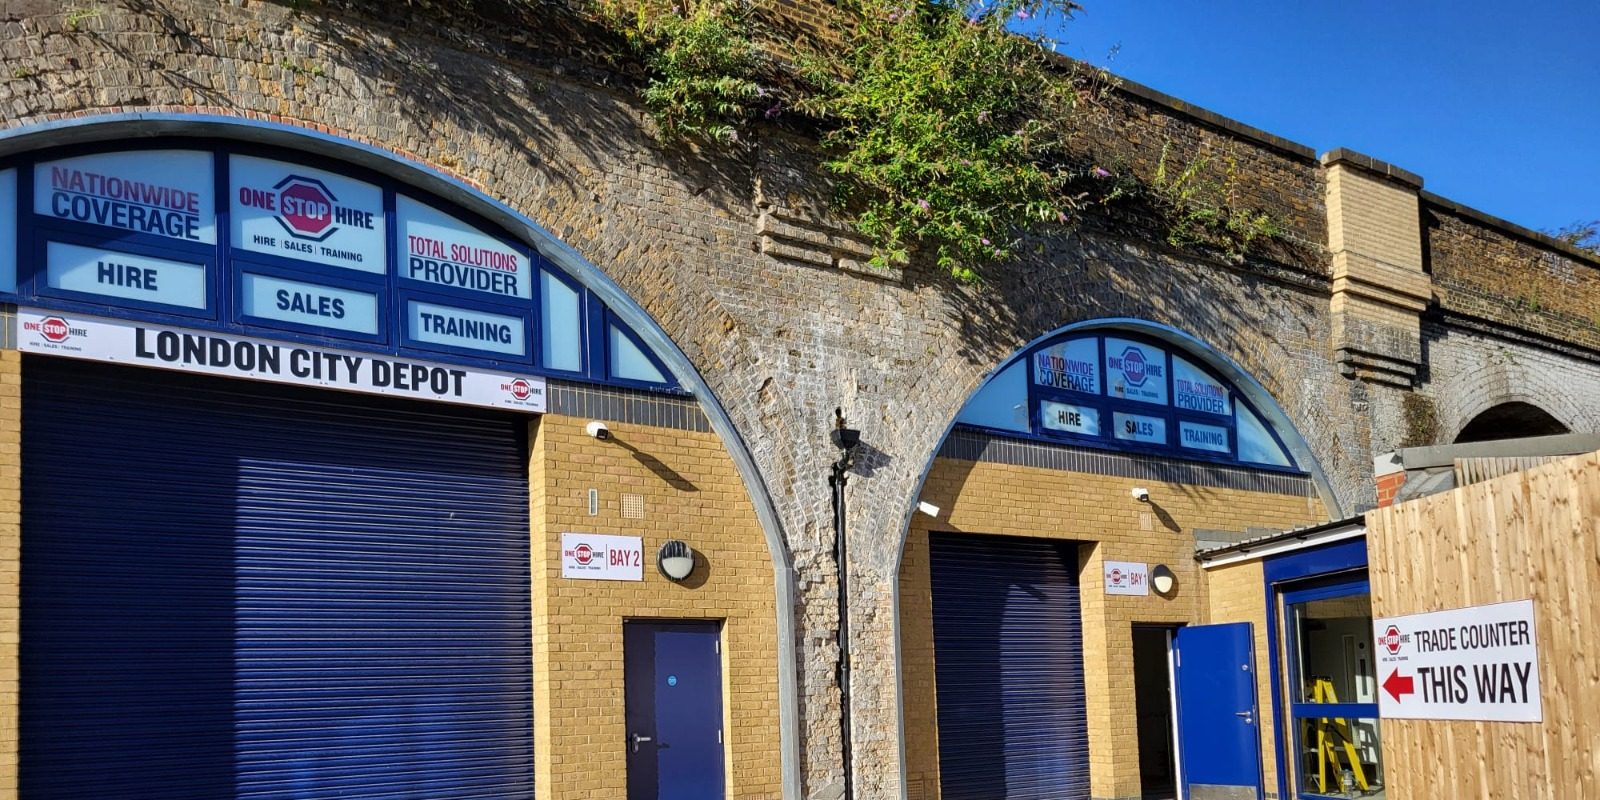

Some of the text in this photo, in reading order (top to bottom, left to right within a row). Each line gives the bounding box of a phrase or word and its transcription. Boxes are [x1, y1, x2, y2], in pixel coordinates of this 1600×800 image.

[51, 166, 199, 213] NATIONWIDE
[51, 191, 200, 240] COVERAGE
[239, 187, 374, 230] ONE STOP HIRE
[253, 234, 363, 263] HIRE SALES TRAINING
[408, 235, 517, 273] TOTAL SOLUTIONS
[97, 261, 158, 291] HIRE
[409, 257, 518, 296] PROVIDER
[276, 288, 345, 320] SALES
[24, 322, 88, 337] ONE STOP HIRE
[420, 312, 512, 344] TRAINING
[135, 327, 466, 397] LONDON CITY DEPOT
[1039, 354, 1094, 375] NATIONWIDE
[1109, 356, 1163, 378] ONE STOP HIRE
[500, 383, 512, 391] ONE
[513, 385, 529, 394] STOP
[1040, 370, 1095, 393] COVERAGE
[1176, 379, 1223, 398] TOTAL SOLUTIONS
[1178, 393, 1224, 413] PROVIDER
[1058, 410, 1082, 427] HIRE
[1125, 420, 1154, 436] SALES
[1183, 428, 1223, 446] TRAINING
[610, 549, 640, 567] BAY 2
[1131, 573, 1142, 585] BAY
[1143, 574, 1148, 586] 1
[1378, 636, 1386, 646] ONE
[1387, 635, 1399, 645] STOP
[1414, 620, 1530, 653] TRADE COUNTER
[1417, 661, 1532, 704] THIS WAY
